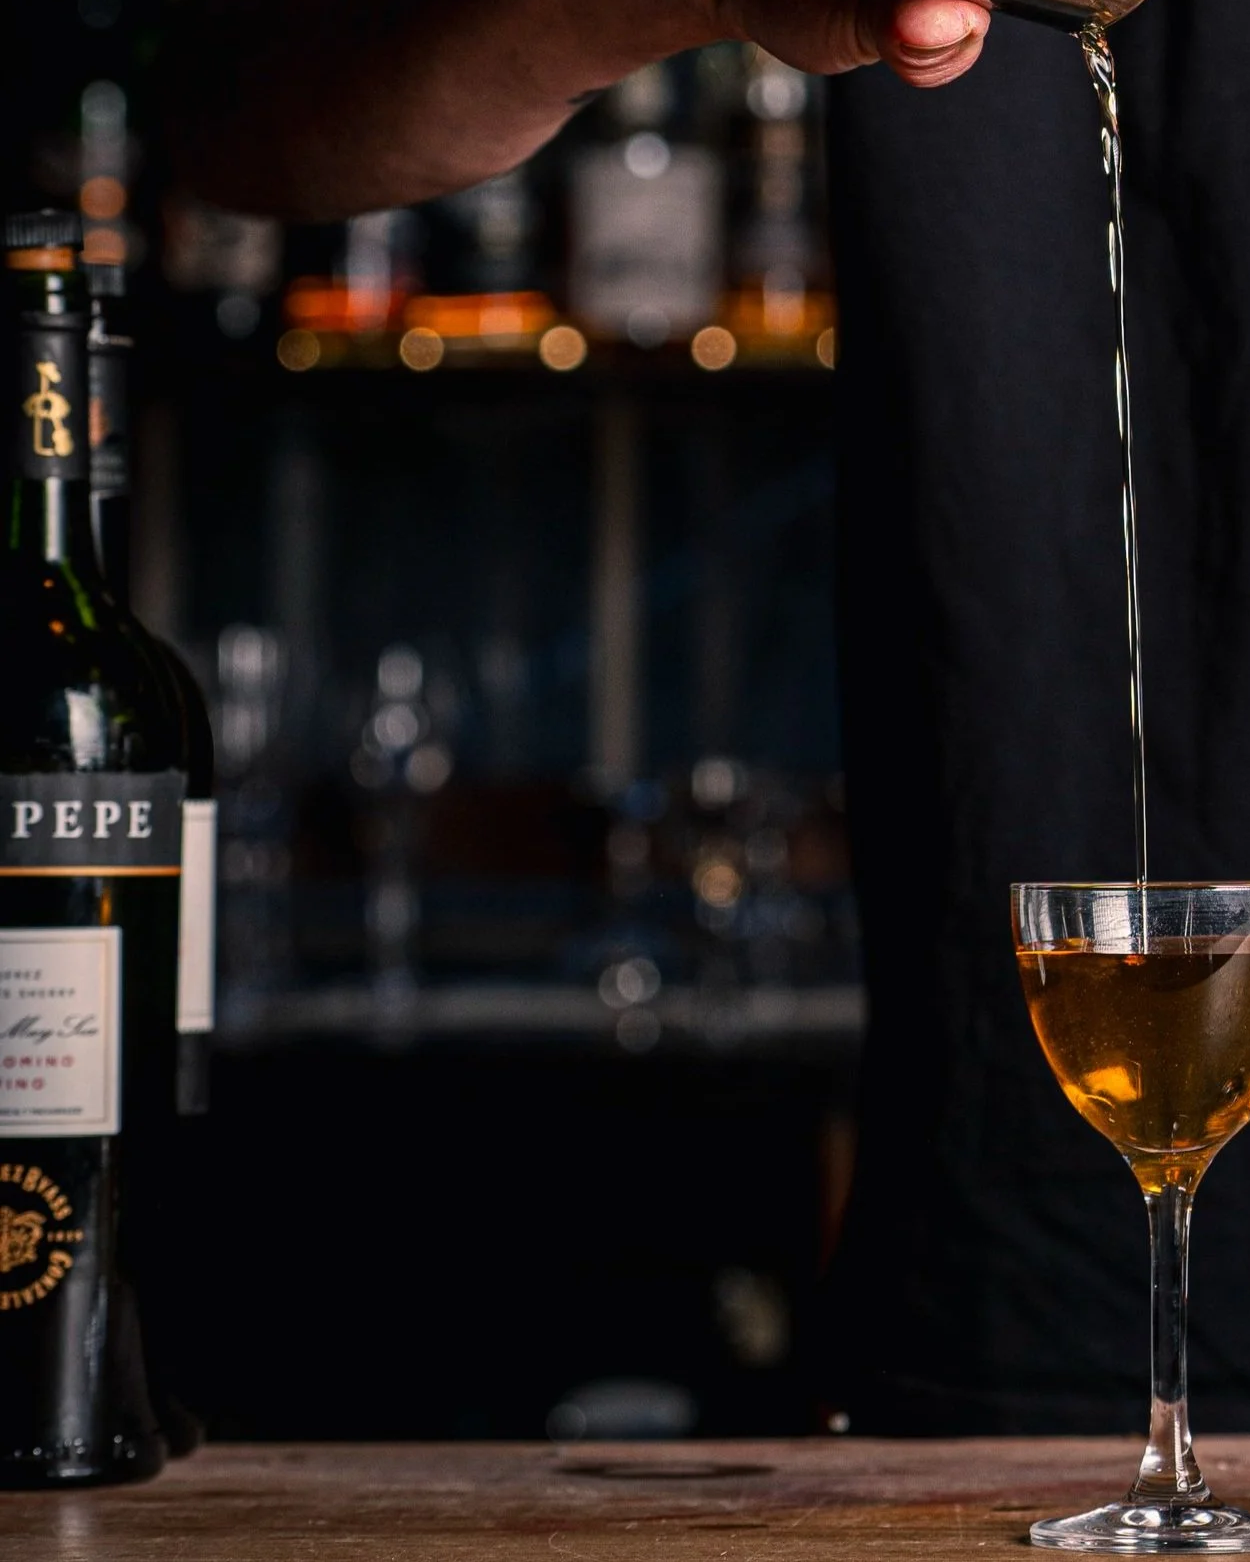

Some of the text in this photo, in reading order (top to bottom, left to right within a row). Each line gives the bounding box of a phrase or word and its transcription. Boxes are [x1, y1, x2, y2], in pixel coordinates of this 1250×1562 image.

[11, 800, 152, 839] PEPE
[0, 1054, 75, 1069] OMINO
[0, 1076, 45, 1091] INO
[0, 1250, 74, 1310] GONZALE
